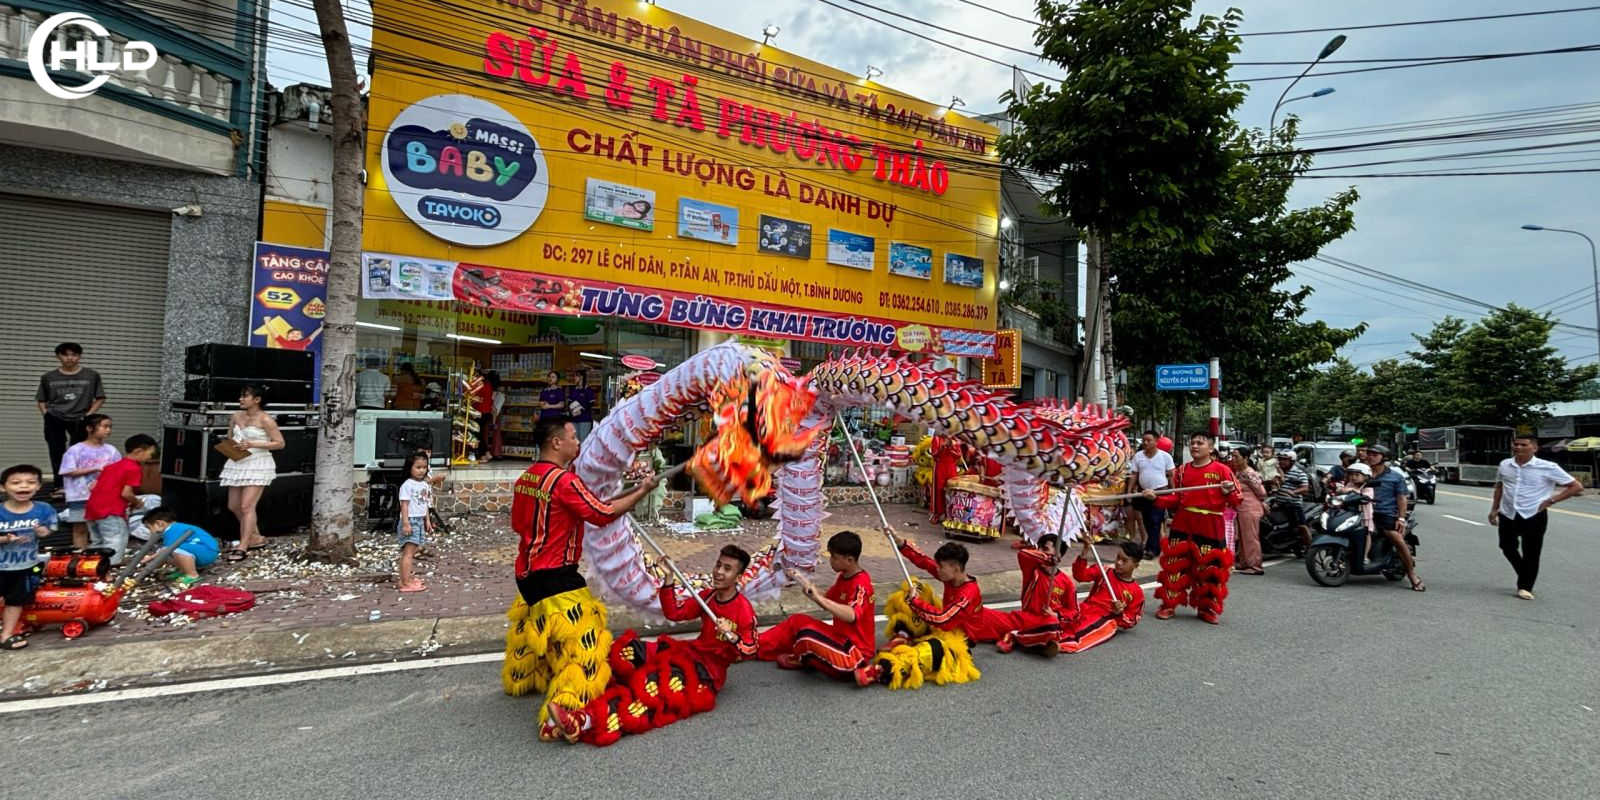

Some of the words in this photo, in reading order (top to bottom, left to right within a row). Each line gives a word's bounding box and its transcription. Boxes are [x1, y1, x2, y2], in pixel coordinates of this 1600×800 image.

[624, 17, 702, 64] PHÂN
[710, 44, 767, 84] PHỐI
[773, 66, 819, 102] SỮA
[822, 81, 850, 110] VÀ
[854, 92, 881, 117] TÃ
[885, 103, 922, 134] 24/7
[927, 112, 959, 145] TÂN
[962, 133, 987, 154] AN
[484, 27, 591, 103] SỮA
[605, 62, 634, 110] &
[648, 72, 704, 132] TÃ
[717, 96, 863, 173] PHƯƠNG
[871, 139, 949, 196] THẢO
[406, 141, 521, 187] BABY
[475, 128, 525, 156] MASSI
[567, 128, 653, 168] CHẤT
[663, 148, 755, 192] LƯỢNG
[764, 171, 791, 200] LÀ
[799, 182, 861, 217] DANH
[868, 203, 897, 229] DỰ
[261, 253, 301, 269] TĂNG
[273, 272, 295, 280] CAO
[298, 272, 325, 284] KHỎE
[543, 243, 567, 262] ĐC:
[572, 247, 593, 266] 297
[597, 246, 610, 267] LÊ
[613, 251, 635, 274] CHÍ
[639, 255, 667, 279] DÂN,
[670, 259, 699, 282] P.TÂN
[702, 268, 720, 287] AN,
[724, 269, 755, 290] TP.THỦ
[780, 279, 802, 298] MỘT,
[804, 280, 831, 301] T.BÌNH
[833, 286, 863, 305] DƯƠNG
[267, 290, 293, 302] 52
[580, 288, 663, 319] TƯNG
[669, 295, 746, 328] BỪNG
[749, 308, 807, 336] KHAI
[810, 316, 897, 345] TRƯƠNG
[879, 291, 890, 309] ĐT:
[892, 295, 940, 314] 0362.254.610
[945, 301, 989, 320] 0385.286.379
